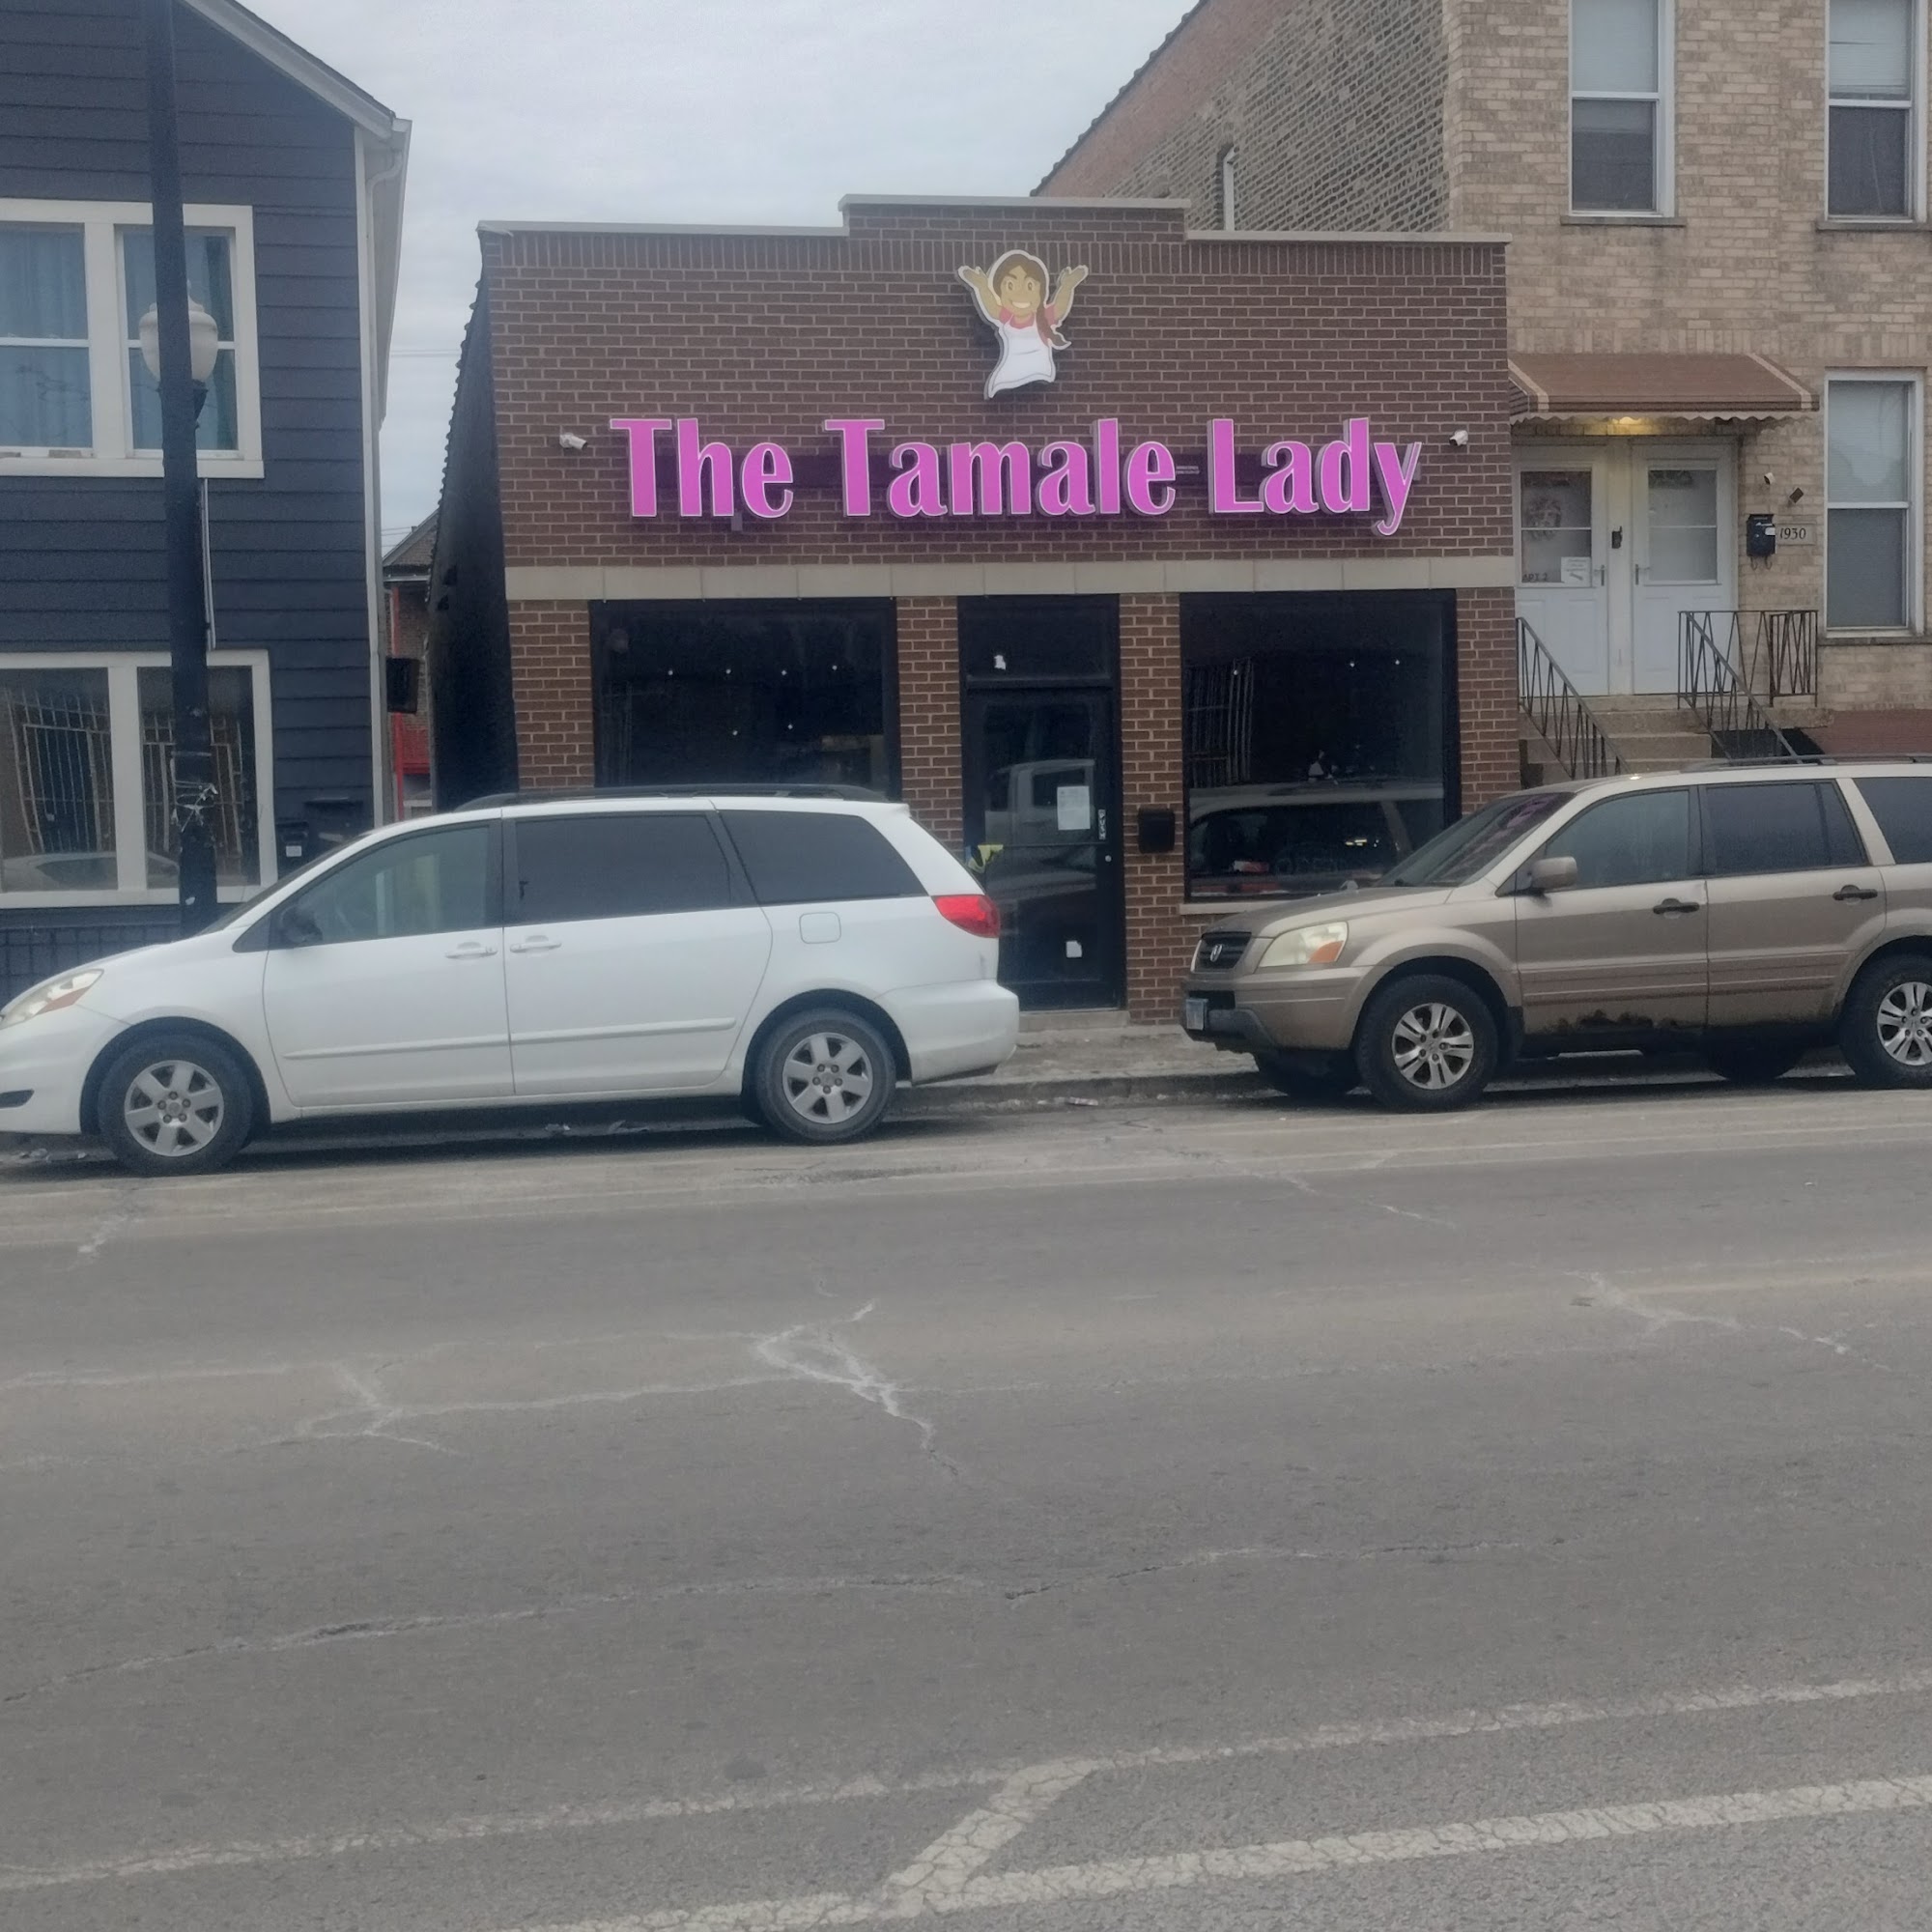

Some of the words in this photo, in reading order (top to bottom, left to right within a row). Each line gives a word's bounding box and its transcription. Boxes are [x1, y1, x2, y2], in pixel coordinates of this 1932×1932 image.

[609, 417, 795, 518] The
[824, 417, 1177, 516] Tamale
[1207, 416, 1423, 536] Lady
[1779, 527, 1806, 540] 1930
